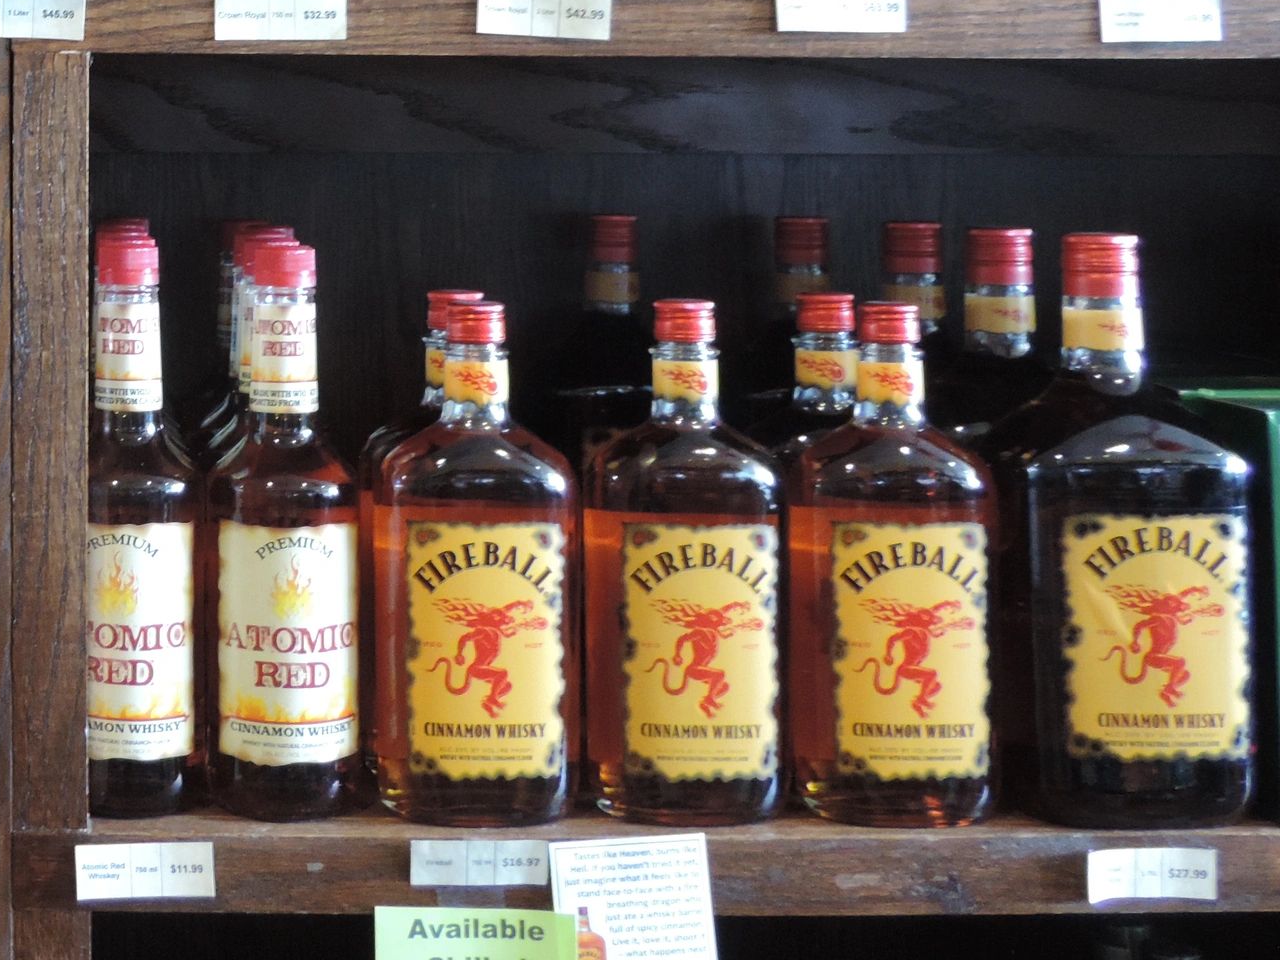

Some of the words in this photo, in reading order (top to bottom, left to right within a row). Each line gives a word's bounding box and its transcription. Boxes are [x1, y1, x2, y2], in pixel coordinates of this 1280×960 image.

[262, 341, 304, 357] RED
[255, 536, 334, 561] PREMIUM
[1082, 526, 1229, 580] FIREBALL
[412, 541, 553, 595] FIREBALL
[629, 542, 769, 594] FIREBALL
[839, 541, 979, 594] FIREBALL
[225, 621, 355, 654] ATOMIC
[88, 656, 154, 686] RED
[254, 660, 331, 689] RED
[128, 720, 181, 734] WHISKY
[230, 721, 305, 738] CINNAMON
[308, 721, 353, 738] WHISKY
[424, 721, 491, 738] CINNAMON
[496, 722, 547, 738] WHISKY
[1097, 713, 1171, 729] CINNAMON
[1173, 713, 1227, 729] WHISKY
[640, 722, 708, 739] CINNAMON
[712, 723, 763, 739] WHISKY
[852, 722, 921, 738] CINNAMON
[925, 723, 976, 738] WHISKY
[81, 863, 107, 872] Atomic
[109, 862, 125, 871] Red
[170, 864, 204, 875] $11.99
[1168, 868, 1208, 880] $27.99
[87, 871, 120, 881] Whiskey
[407, 918, 545, 941] Available
